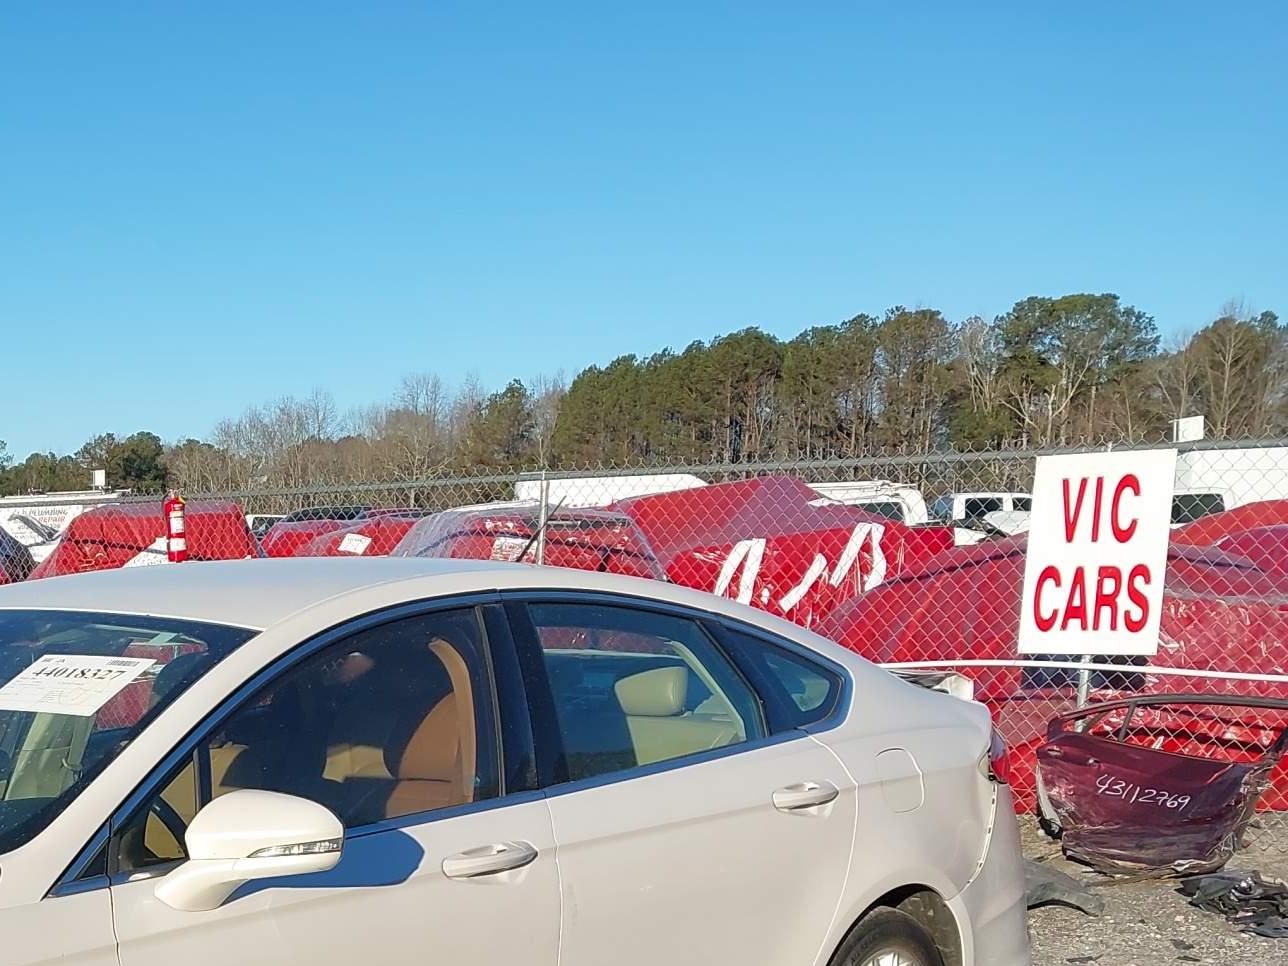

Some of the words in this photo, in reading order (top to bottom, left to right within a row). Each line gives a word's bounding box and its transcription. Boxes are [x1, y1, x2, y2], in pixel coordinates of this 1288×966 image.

[1062, 474, 1141, 543] VIC
[1033, 563, 1152, 633] CARS
[32, 665, 127, 681] 44018327
[1096, 774, 1191, 812] 43112769
